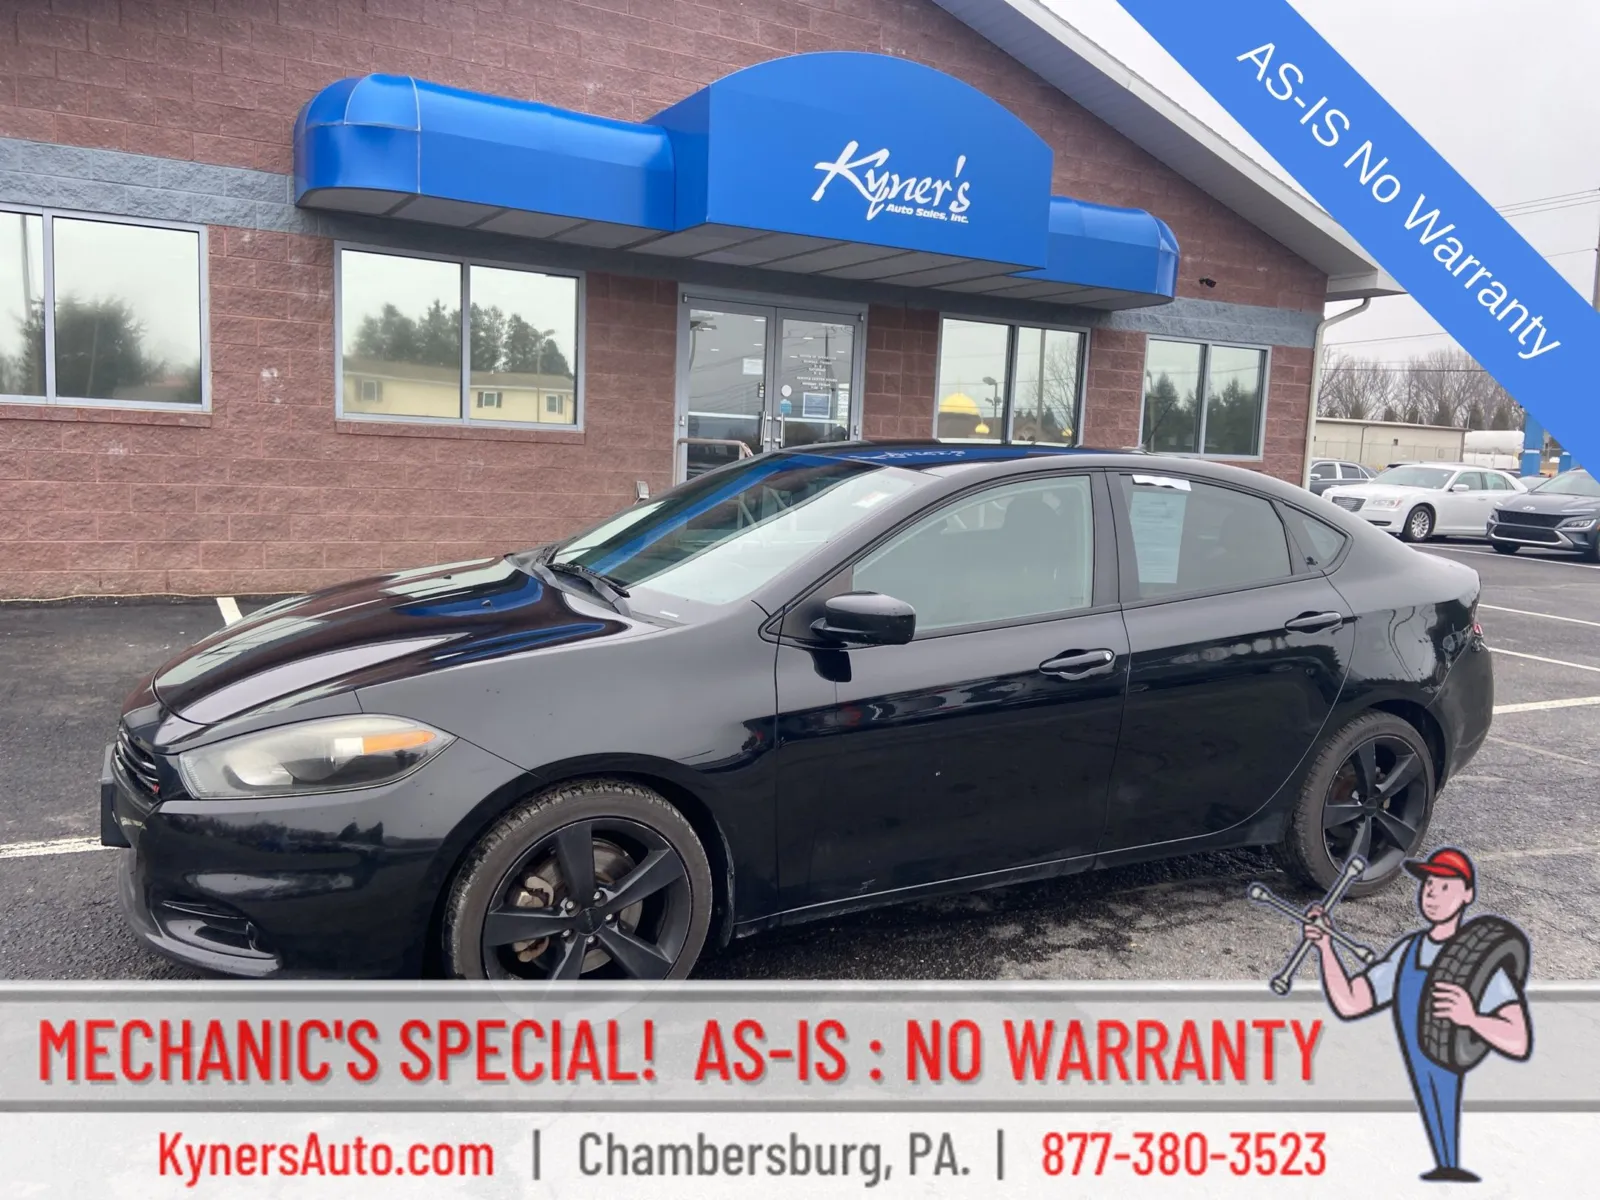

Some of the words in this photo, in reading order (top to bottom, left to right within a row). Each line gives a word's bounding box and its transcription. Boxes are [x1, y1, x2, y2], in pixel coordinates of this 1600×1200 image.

[811, 140, 971, 220] Kyner's
[886, 203, 913, 215] Auto
[916, 207, 948, 221] Sales,
[951, 213, 969, 224] Inc.
